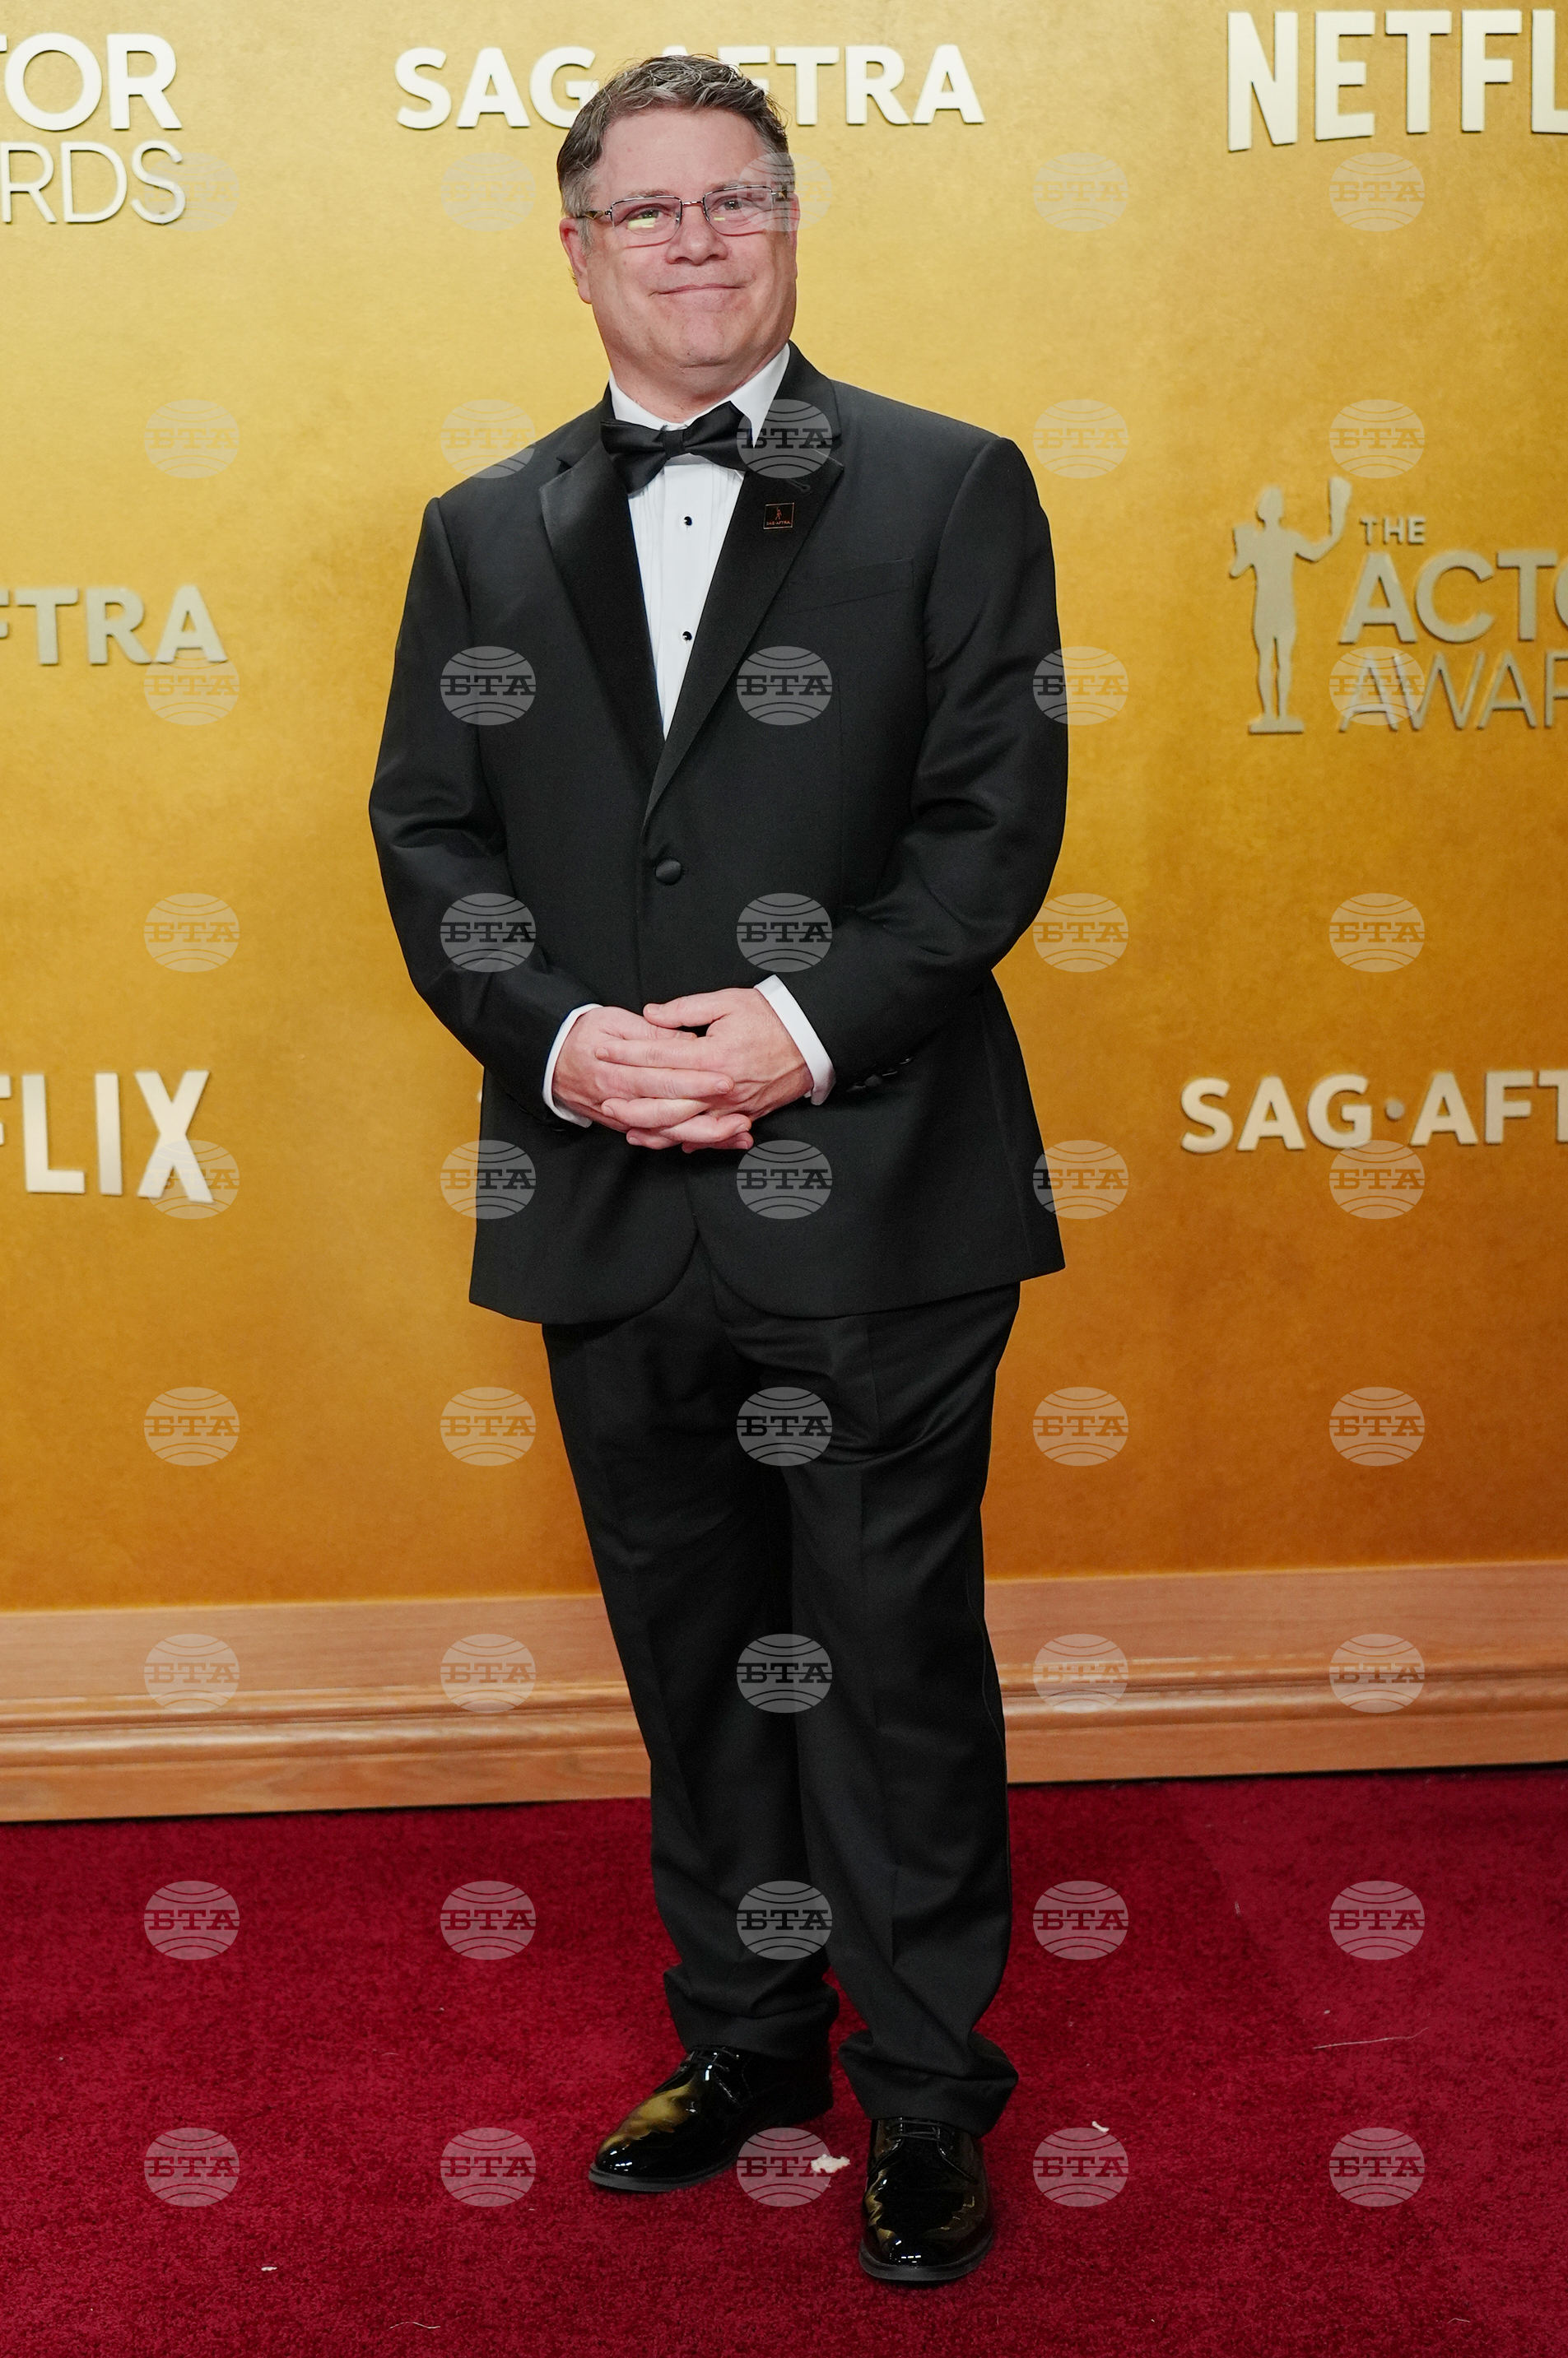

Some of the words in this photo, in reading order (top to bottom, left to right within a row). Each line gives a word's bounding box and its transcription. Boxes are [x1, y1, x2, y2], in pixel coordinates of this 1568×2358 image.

[0, 32, 182, 132] OR
[0, 139, 186, 225] RDS
[1361, 516, 1426, 544] THE
[0, 585, 229, 665] TRA
[1338, 548, 1568, 644] ACT
[0, 1070, 214, 1204] LIX
